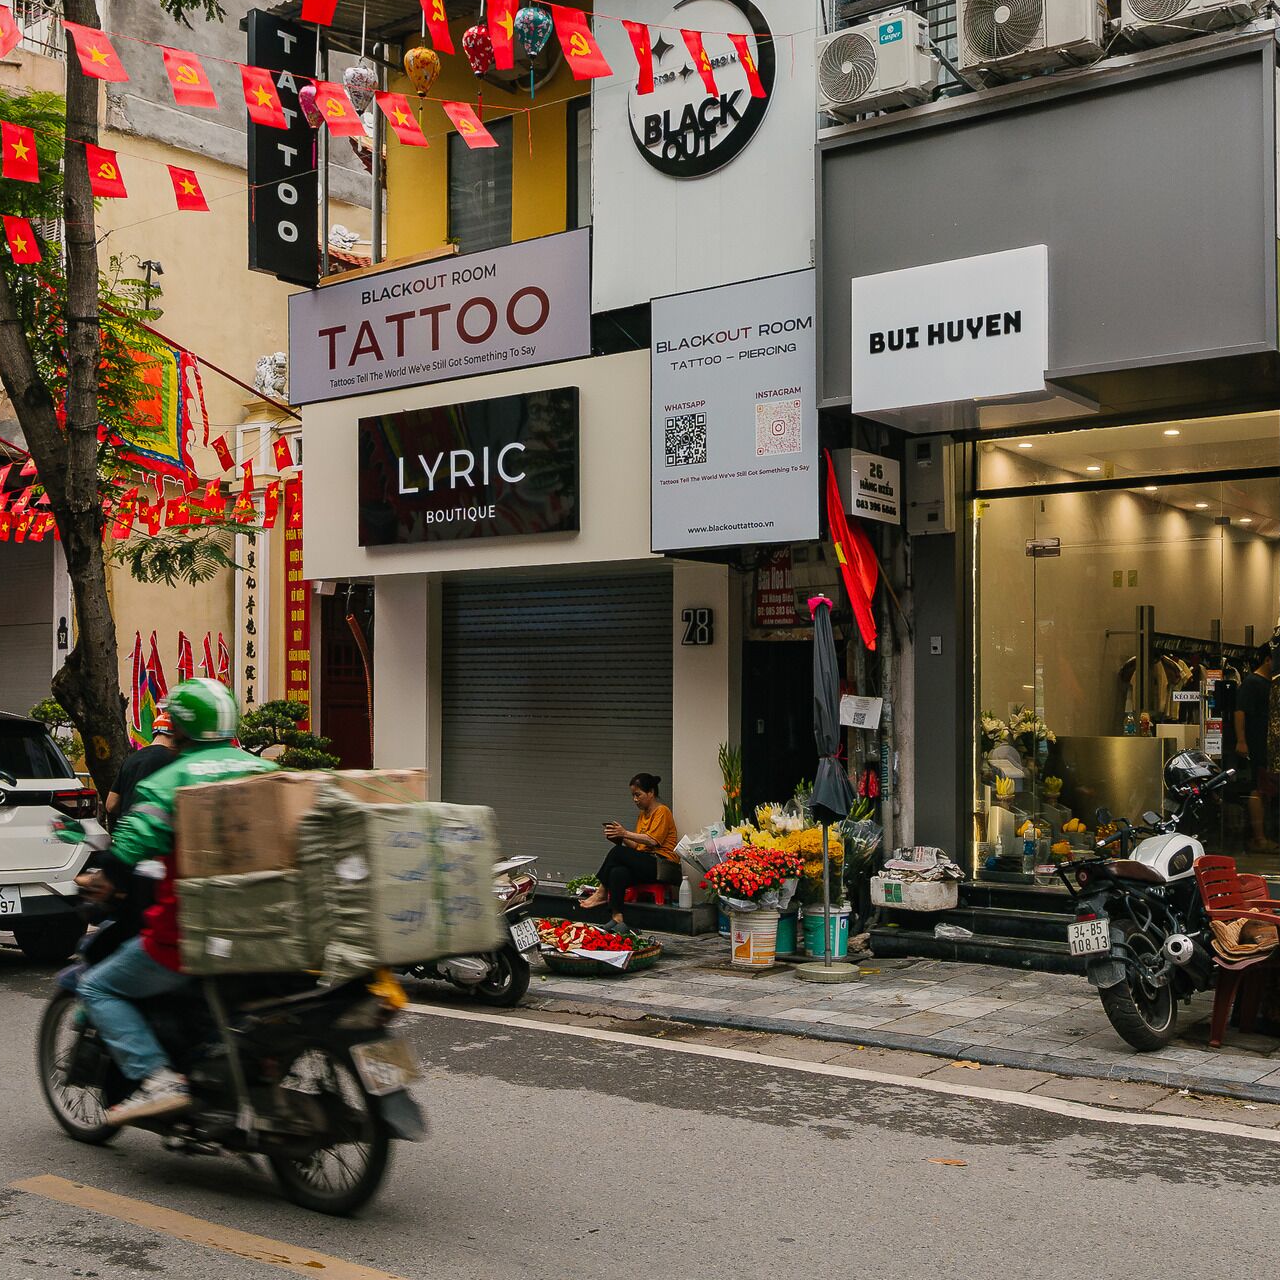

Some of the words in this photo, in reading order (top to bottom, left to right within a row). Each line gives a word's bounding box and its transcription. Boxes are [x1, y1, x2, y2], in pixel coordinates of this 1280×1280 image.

[880, 31, 901, 42] Casper
[644, 89, 744, 148] BLACK
[277, 29, 299, 243] TATTOO
[661, 129, 717, 160] OUT
[361, 274, 447, 304] BLACKOUT
[452, 264, 496, 286] ROOM
[318, 286, 550, 370] TATTOO
[656, 326, 752, 353] BLACKOUT
[758, 316, 812, 336] ROOM
[870, 326, 919, 354] BUI
[927, 310, 1022, 346] HUYEN
[329, 376, 355, 389] Tattoos
[356, 374, 369, 384] Tell
[370, 372, 383, 382] The
[385, 367, 407, 379] World
[408, 365, 431, 375] We've
[432, 360, 447, 371] Still
[448, 358, 462, 368] Got
[464, 350, 508, 365] Something
[510, 347, 520, 357] To
[521, 345, 537, 357] Say
[670, 355, 722, 371] TATTOO
[738, 343, 797, 360] PIERCING
[664, 400, 706, 412] WHATSAPP
[755, 386, 802, 400] INSTAGRAM
[398, 442, 526, 494] LYRIC
[659, 478, 679, 486] Tattoos
[759, 466, 790, 475] Something
[799, 464, 810, 472] Say
[869, 462, 883, 480] 26
[426, 505, 496, 524] BOUTIQUE
[687, 520, 775, 534] www.blackouttattoo.vn
[681, 607, 714, 645] 28
[1174, 692, 1189, 700] KÉO
[1073, 922, 1102, 938] 34-B5
[1071, 935, 1108, 954] 108.13
